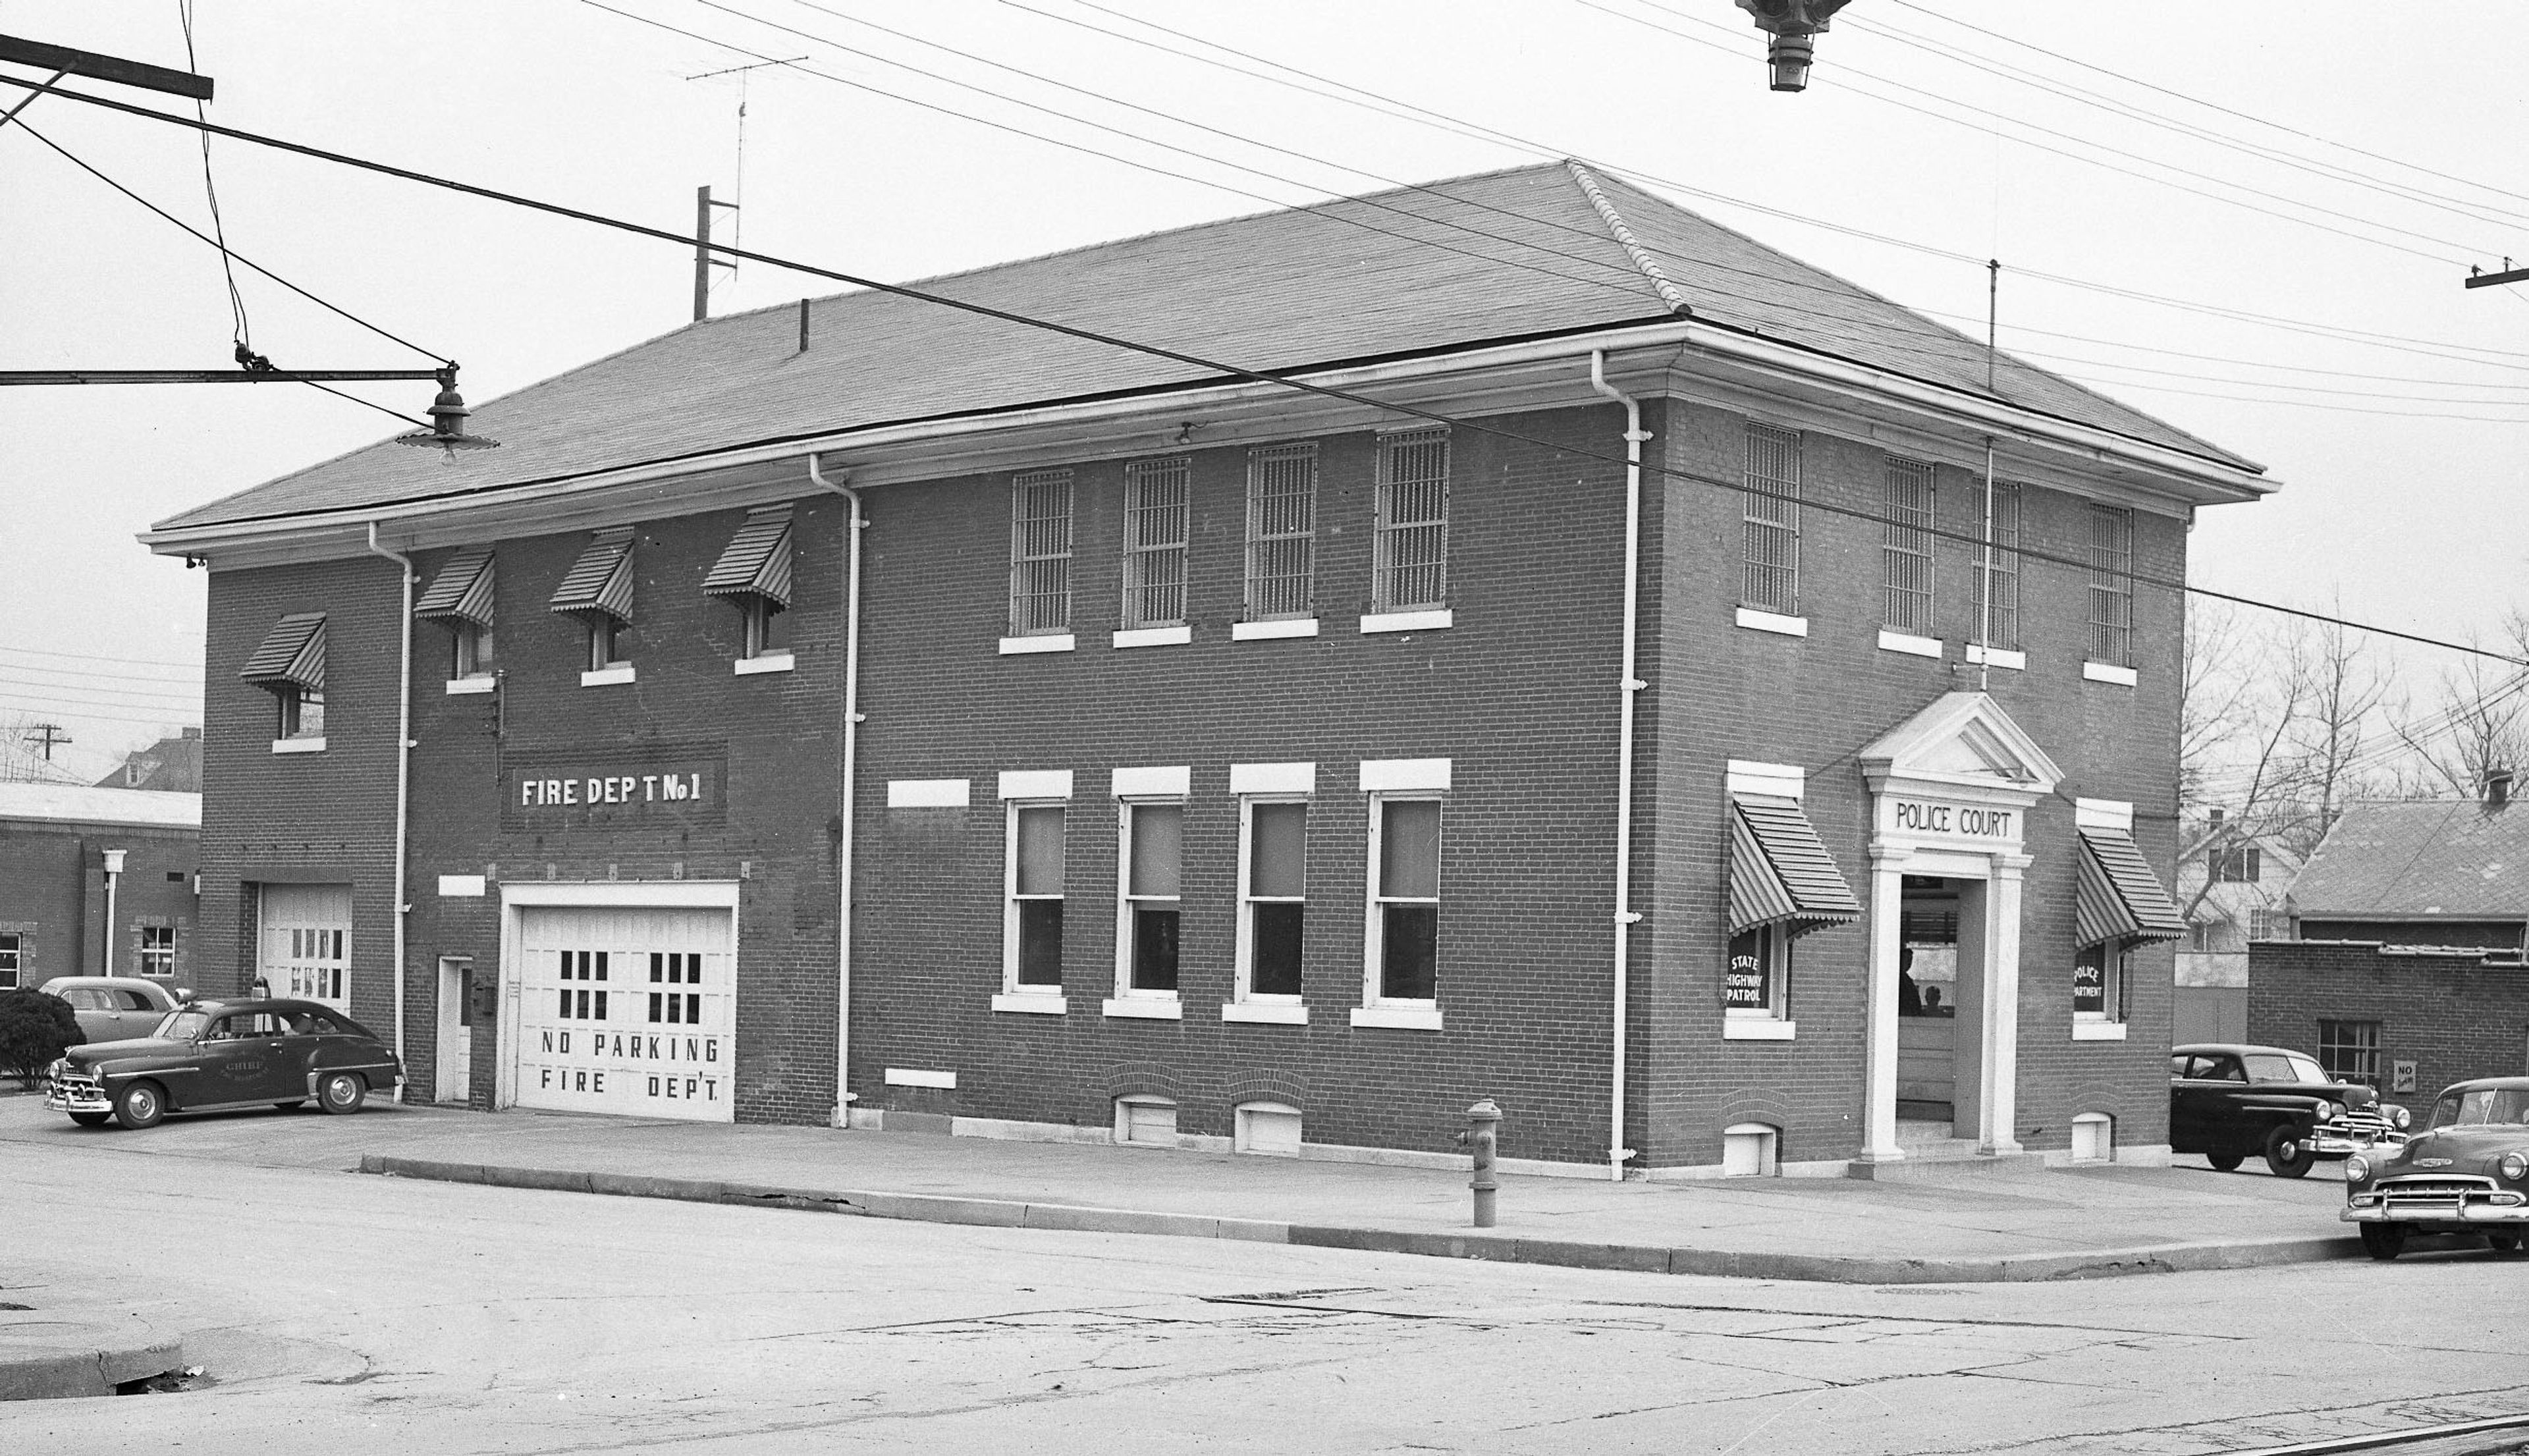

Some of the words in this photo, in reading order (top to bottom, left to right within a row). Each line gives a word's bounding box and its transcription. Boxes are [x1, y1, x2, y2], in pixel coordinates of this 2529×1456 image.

[522, 779, 578, 805] FIRE
[1896, 802, 1951, 832] POLICE
[1960, 808, 2011, 837] COURT
[1731, 955, 1759, 971] STATE
[1727, 973, 1763, 987] HIGHWAY
[2074, 965, 2099, 983] POLICE
[1727, 988, 1761, 1002] PATROL
[542, 1031, 570, 1054] NO
[594, 1034, 717, 1062] PARKING
[2398, 1065, 2412, 1075] NO
[541, 1069, 605, 1093] FIRE
